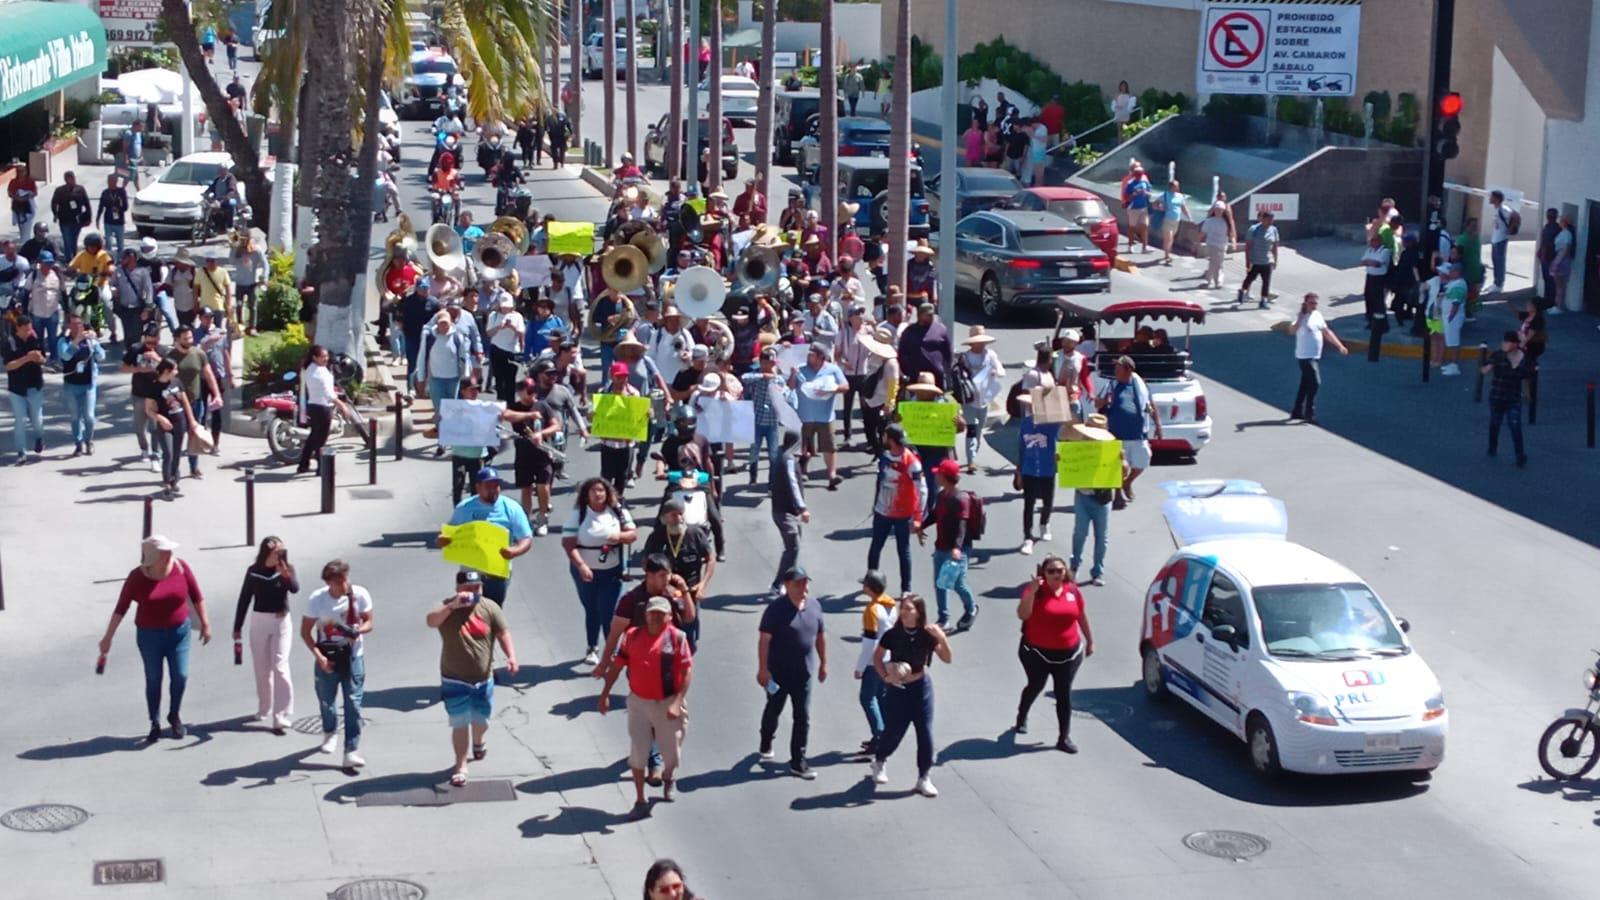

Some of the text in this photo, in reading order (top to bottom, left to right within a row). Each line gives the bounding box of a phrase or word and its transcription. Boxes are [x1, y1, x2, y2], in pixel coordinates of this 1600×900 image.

[1277, 13, 1335, 21] PROHIBIDO
[1276, 26, 1342, 34] ESTACIONAR
[126, 29, 145, 41] 912
[1275, 38, 1309, 46] SOBRE
[1273, 51, 1289, 59] AV.
[0, 30, 95, 102] Ristorante Villa Italia
